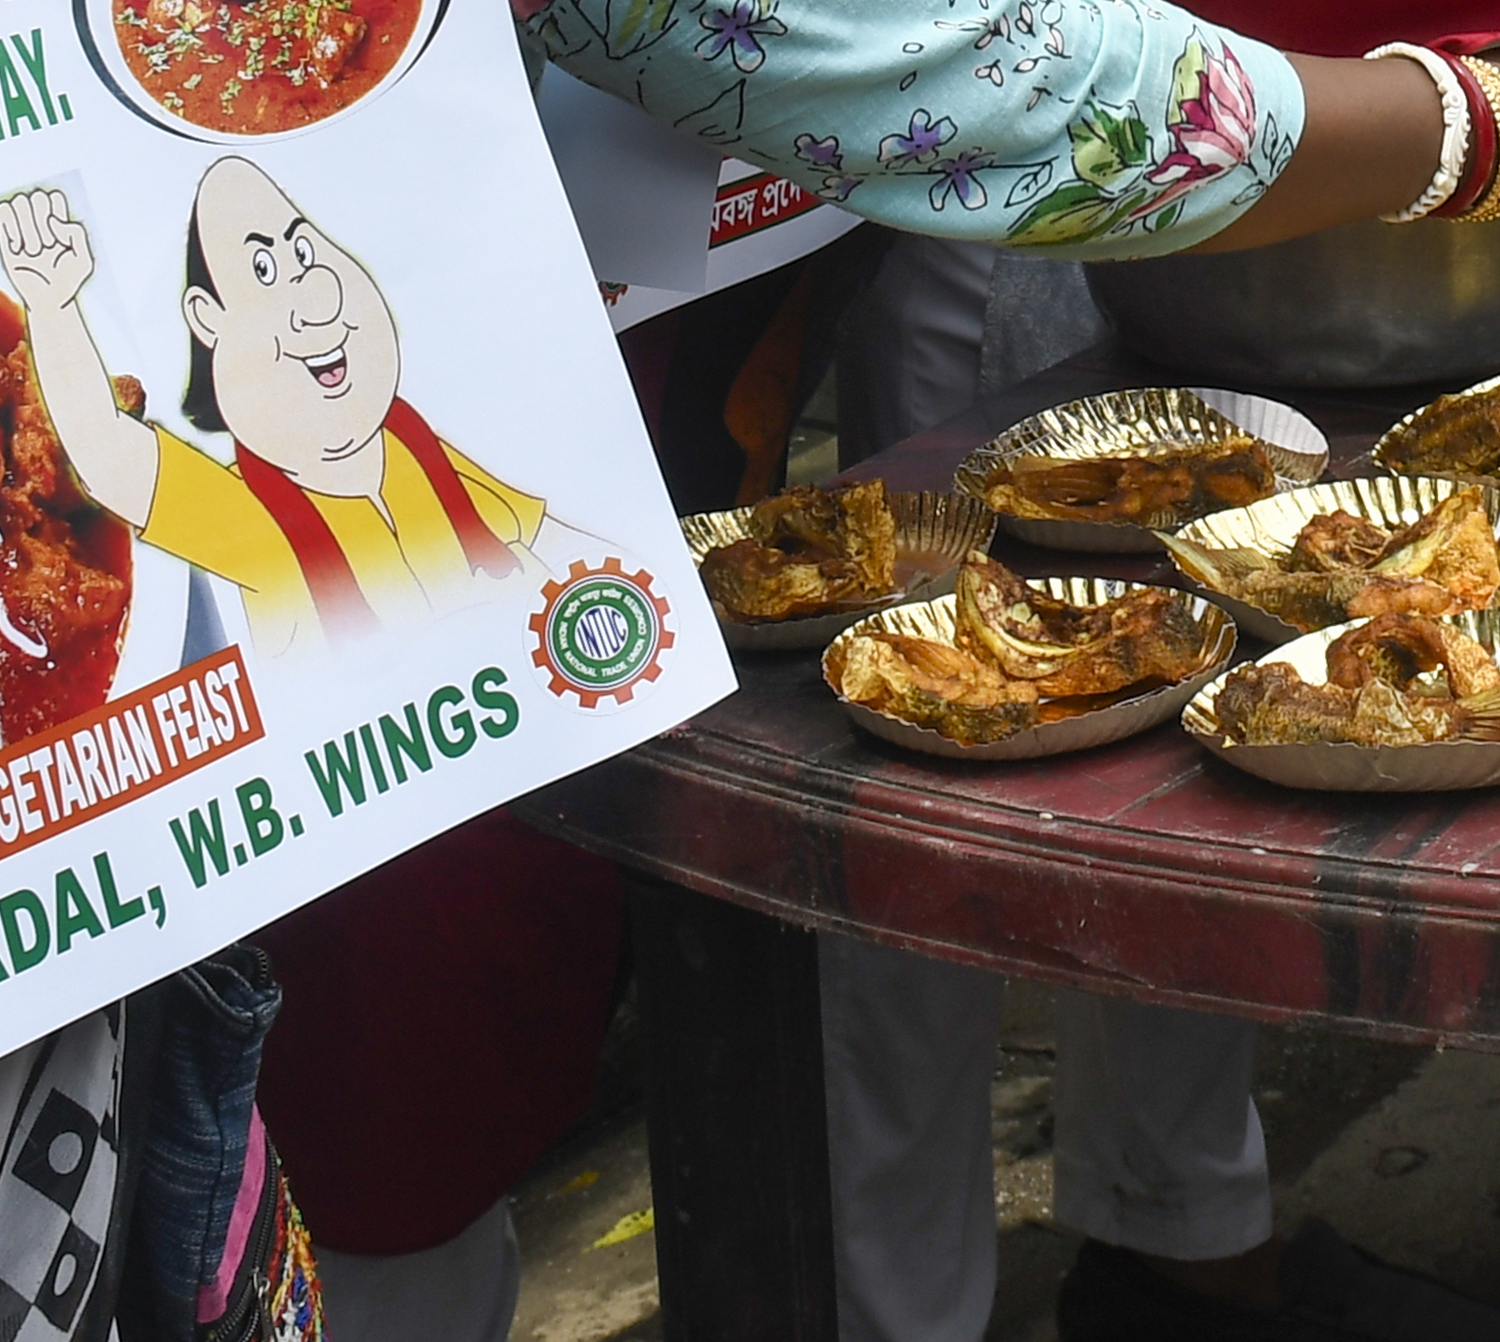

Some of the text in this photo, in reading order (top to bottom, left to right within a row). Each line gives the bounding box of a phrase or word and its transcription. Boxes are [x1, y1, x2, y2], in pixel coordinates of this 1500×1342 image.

[564, 651, 597, 678] NATIONAL
[601, 661, 628, 677] TRADE
[577, 606, 626, 658] INTUC
[152, 661, 252, 767] FEAST
[168, 776, 306, 889] W.B.
[304, 665, 521, 818] WINGS
